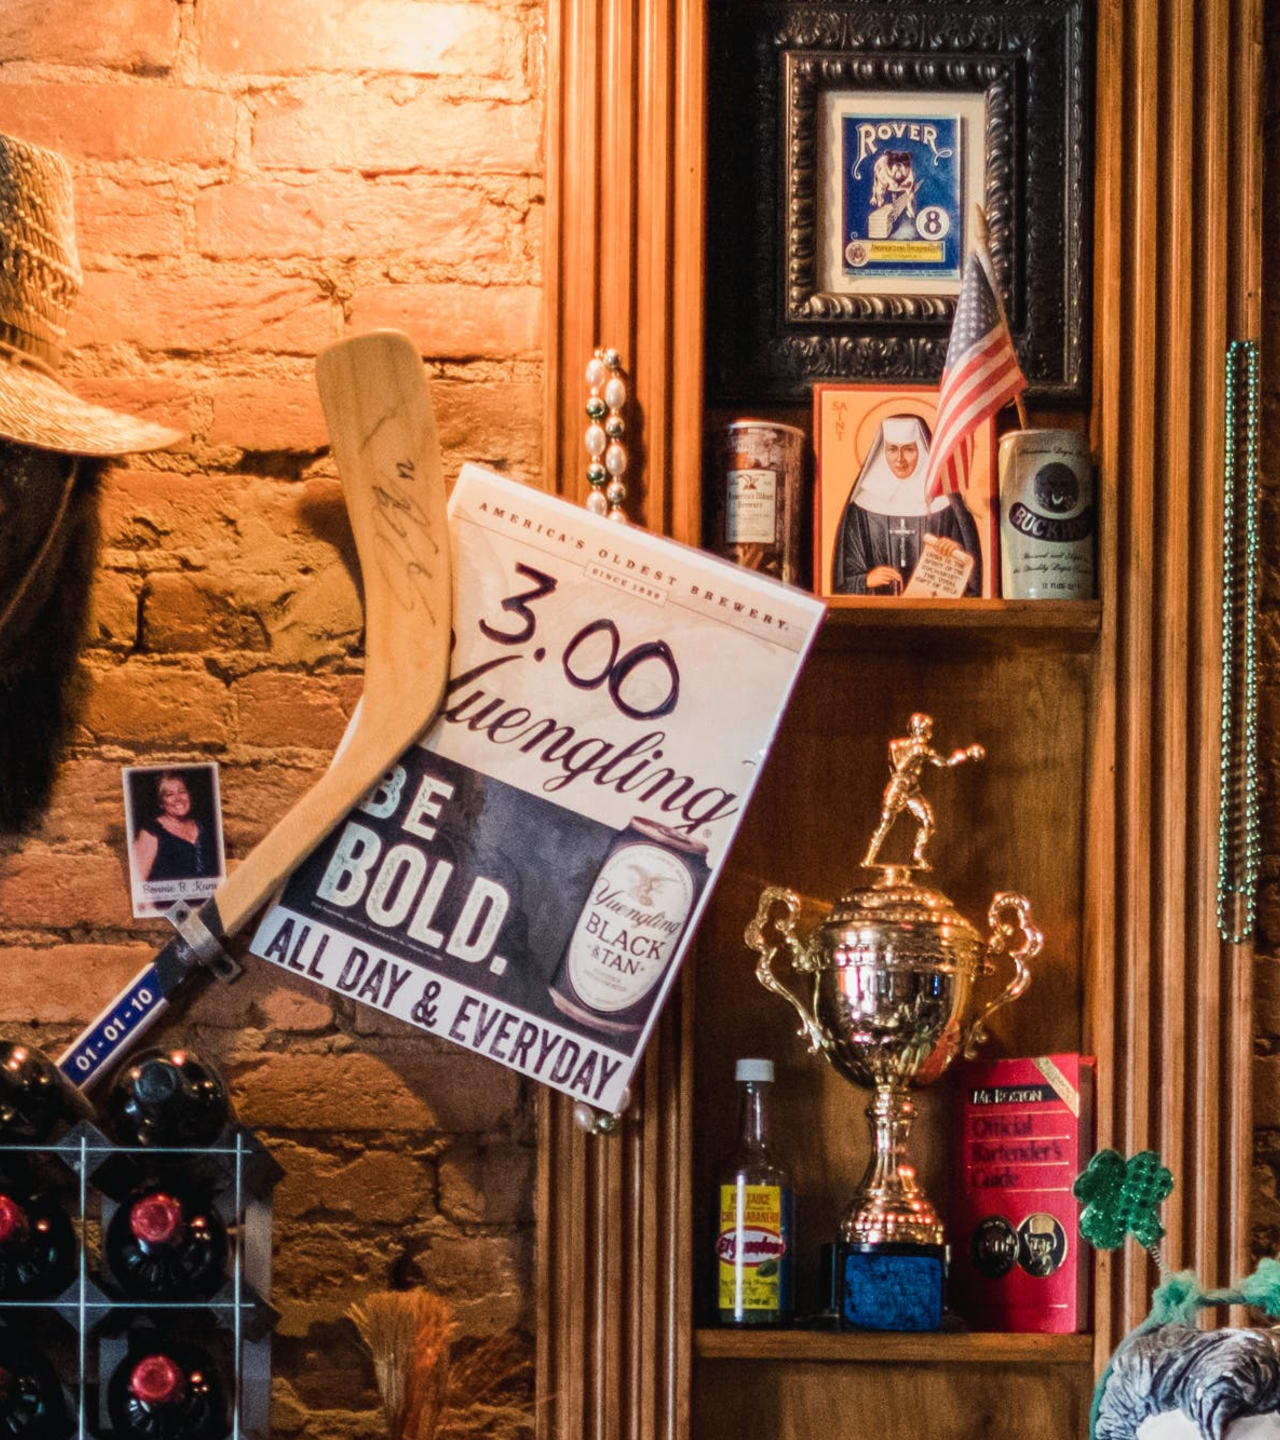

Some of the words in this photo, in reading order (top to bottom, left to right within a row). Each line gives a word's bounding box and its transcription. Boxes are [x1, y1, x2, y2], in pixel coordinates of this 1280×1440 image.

[851, 123, 952, 180] ROVER
[924, 211, 941, 234] 8
[480, 501, 586, 551] AMERICA'S
[597, 548, 678, 587] OLDEST
[479, 561, 680, 721] 3.00
[360, 764, 455, 841] BE
[316, 821, 510, 976] BOLD.
[585, 912, 666, 960] BLACK
[592, 877, 682, 935] Yuengling
[264, 918, 331, 980] ALL
[336, 946, 412, 1010] DAY
[410, 981, 441, 1028] &
[448, 995, 623, 1101] EVERYDAY
